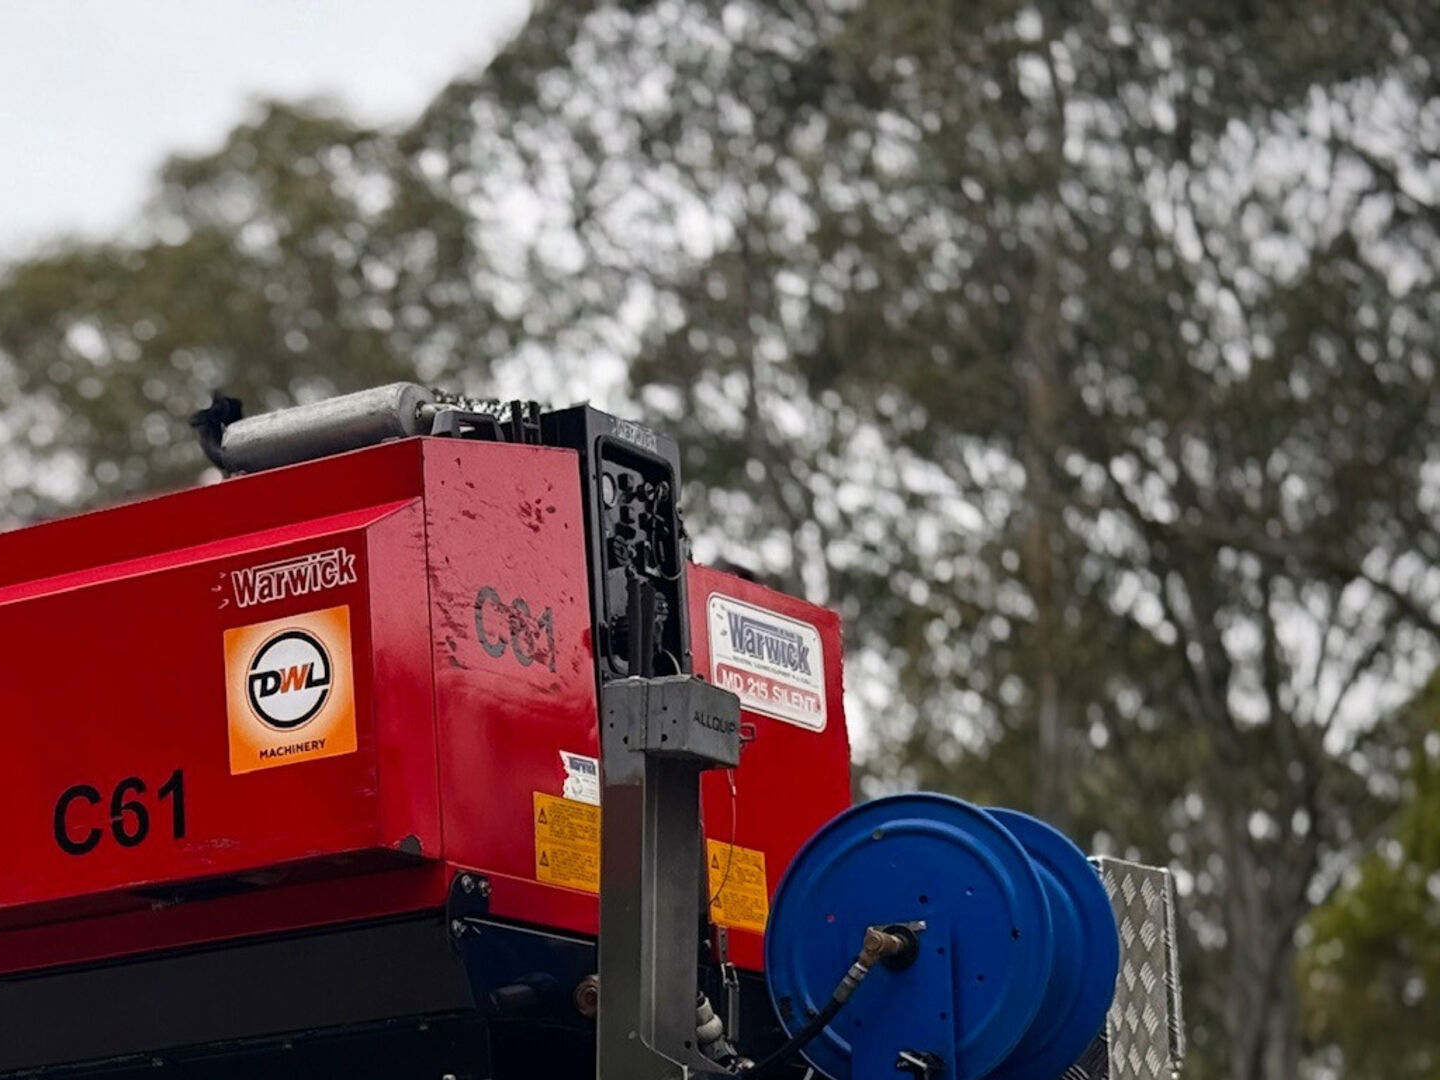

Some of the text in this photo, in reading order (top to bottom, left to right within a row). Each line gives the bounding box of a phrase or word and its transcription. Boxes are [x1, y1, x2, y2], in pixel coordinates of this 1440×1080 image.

[231, 547, 357, 608] Warwick
[728, 611, 812, 676] Warwick
[249, 662, 331, 699] DWL
[722, 668, 744, 693] MD
[748, 678, 769, 700] 215
[772, 686, 817, 713] SILENT
[260, 738, 326, 759] MACHINERY
[53, 768, 186, 856] C61
